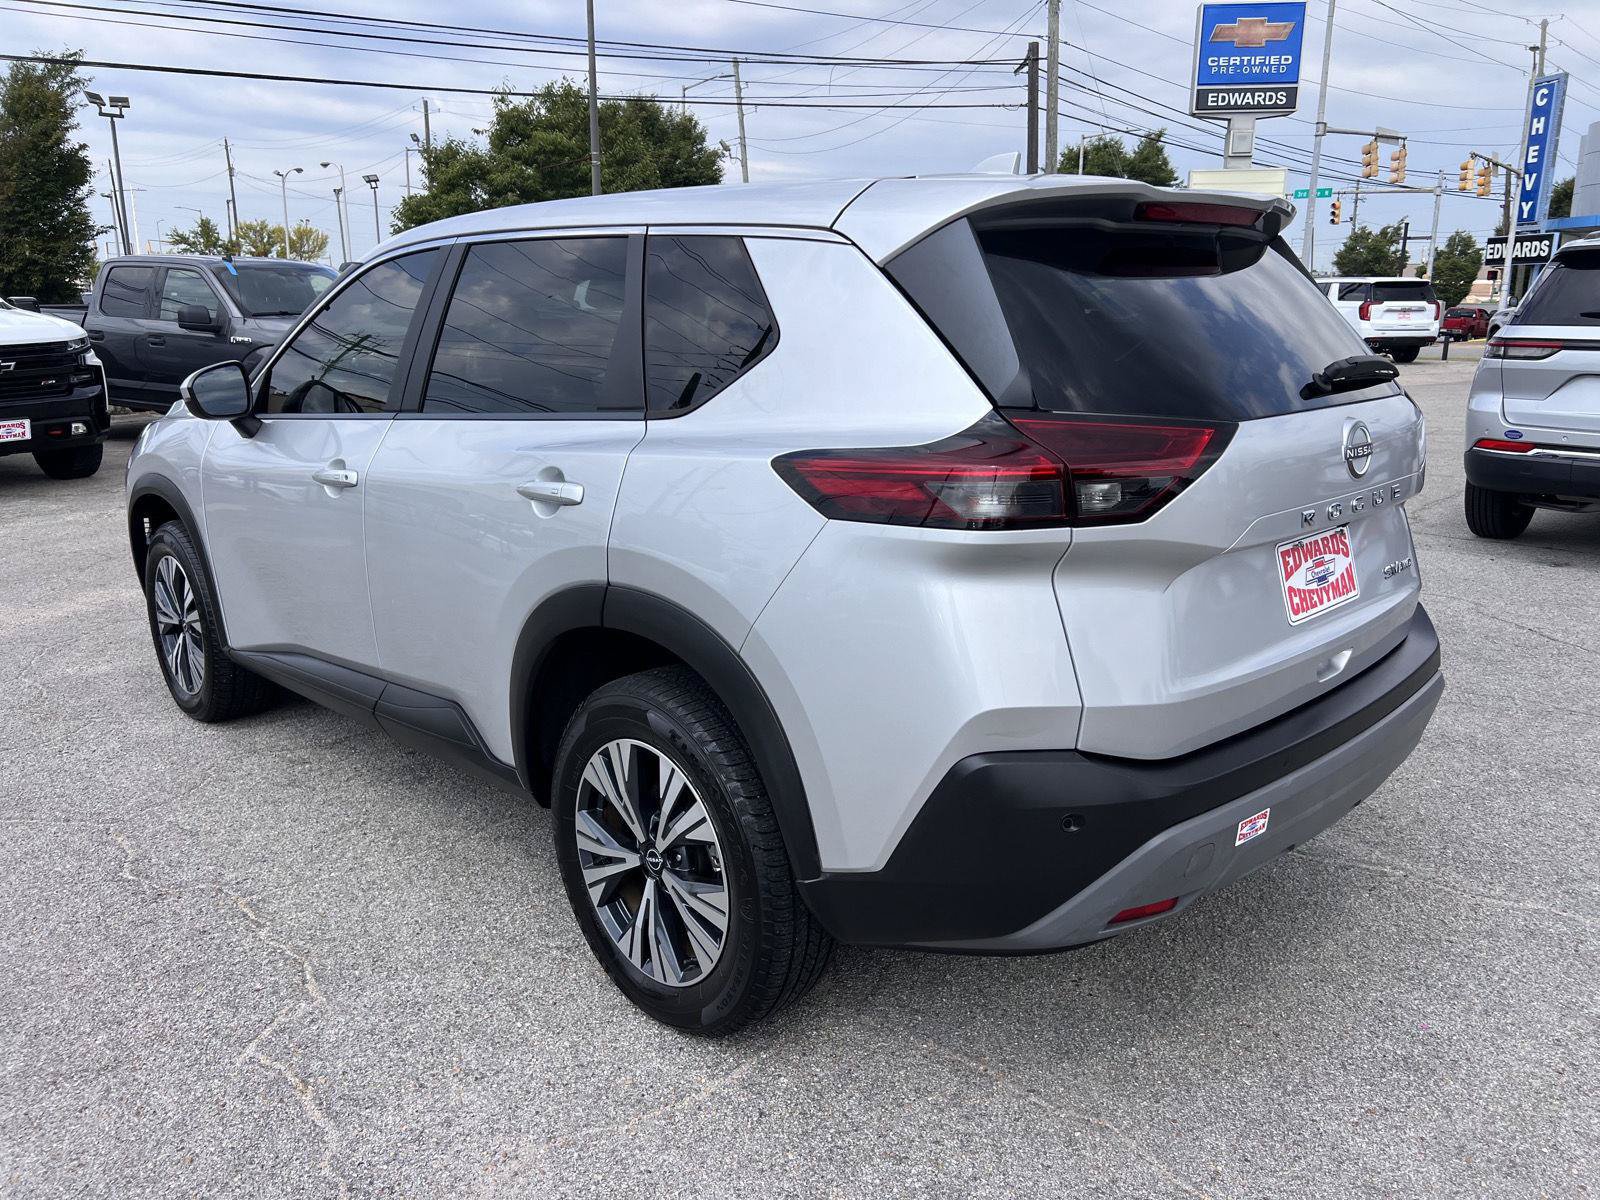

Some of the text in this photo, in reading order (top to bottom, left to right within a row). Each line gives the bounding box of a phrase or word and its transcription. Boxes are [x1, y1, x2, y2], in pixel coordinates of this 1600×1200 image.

[1207, 55, 1293, 66] CERTIFIED
[1211, 65, 1287, 75] PRE-OWNED
[1207, 91, 1287, 106] EDWARDS
[1521, 88, 1549, 219] CHEVY
[1301, 484, 1400, 528] ROGUE
[1280, 533, 1350, 582] EDWARDS
[1287, 562, 1356, 616] CHEVYMAN
